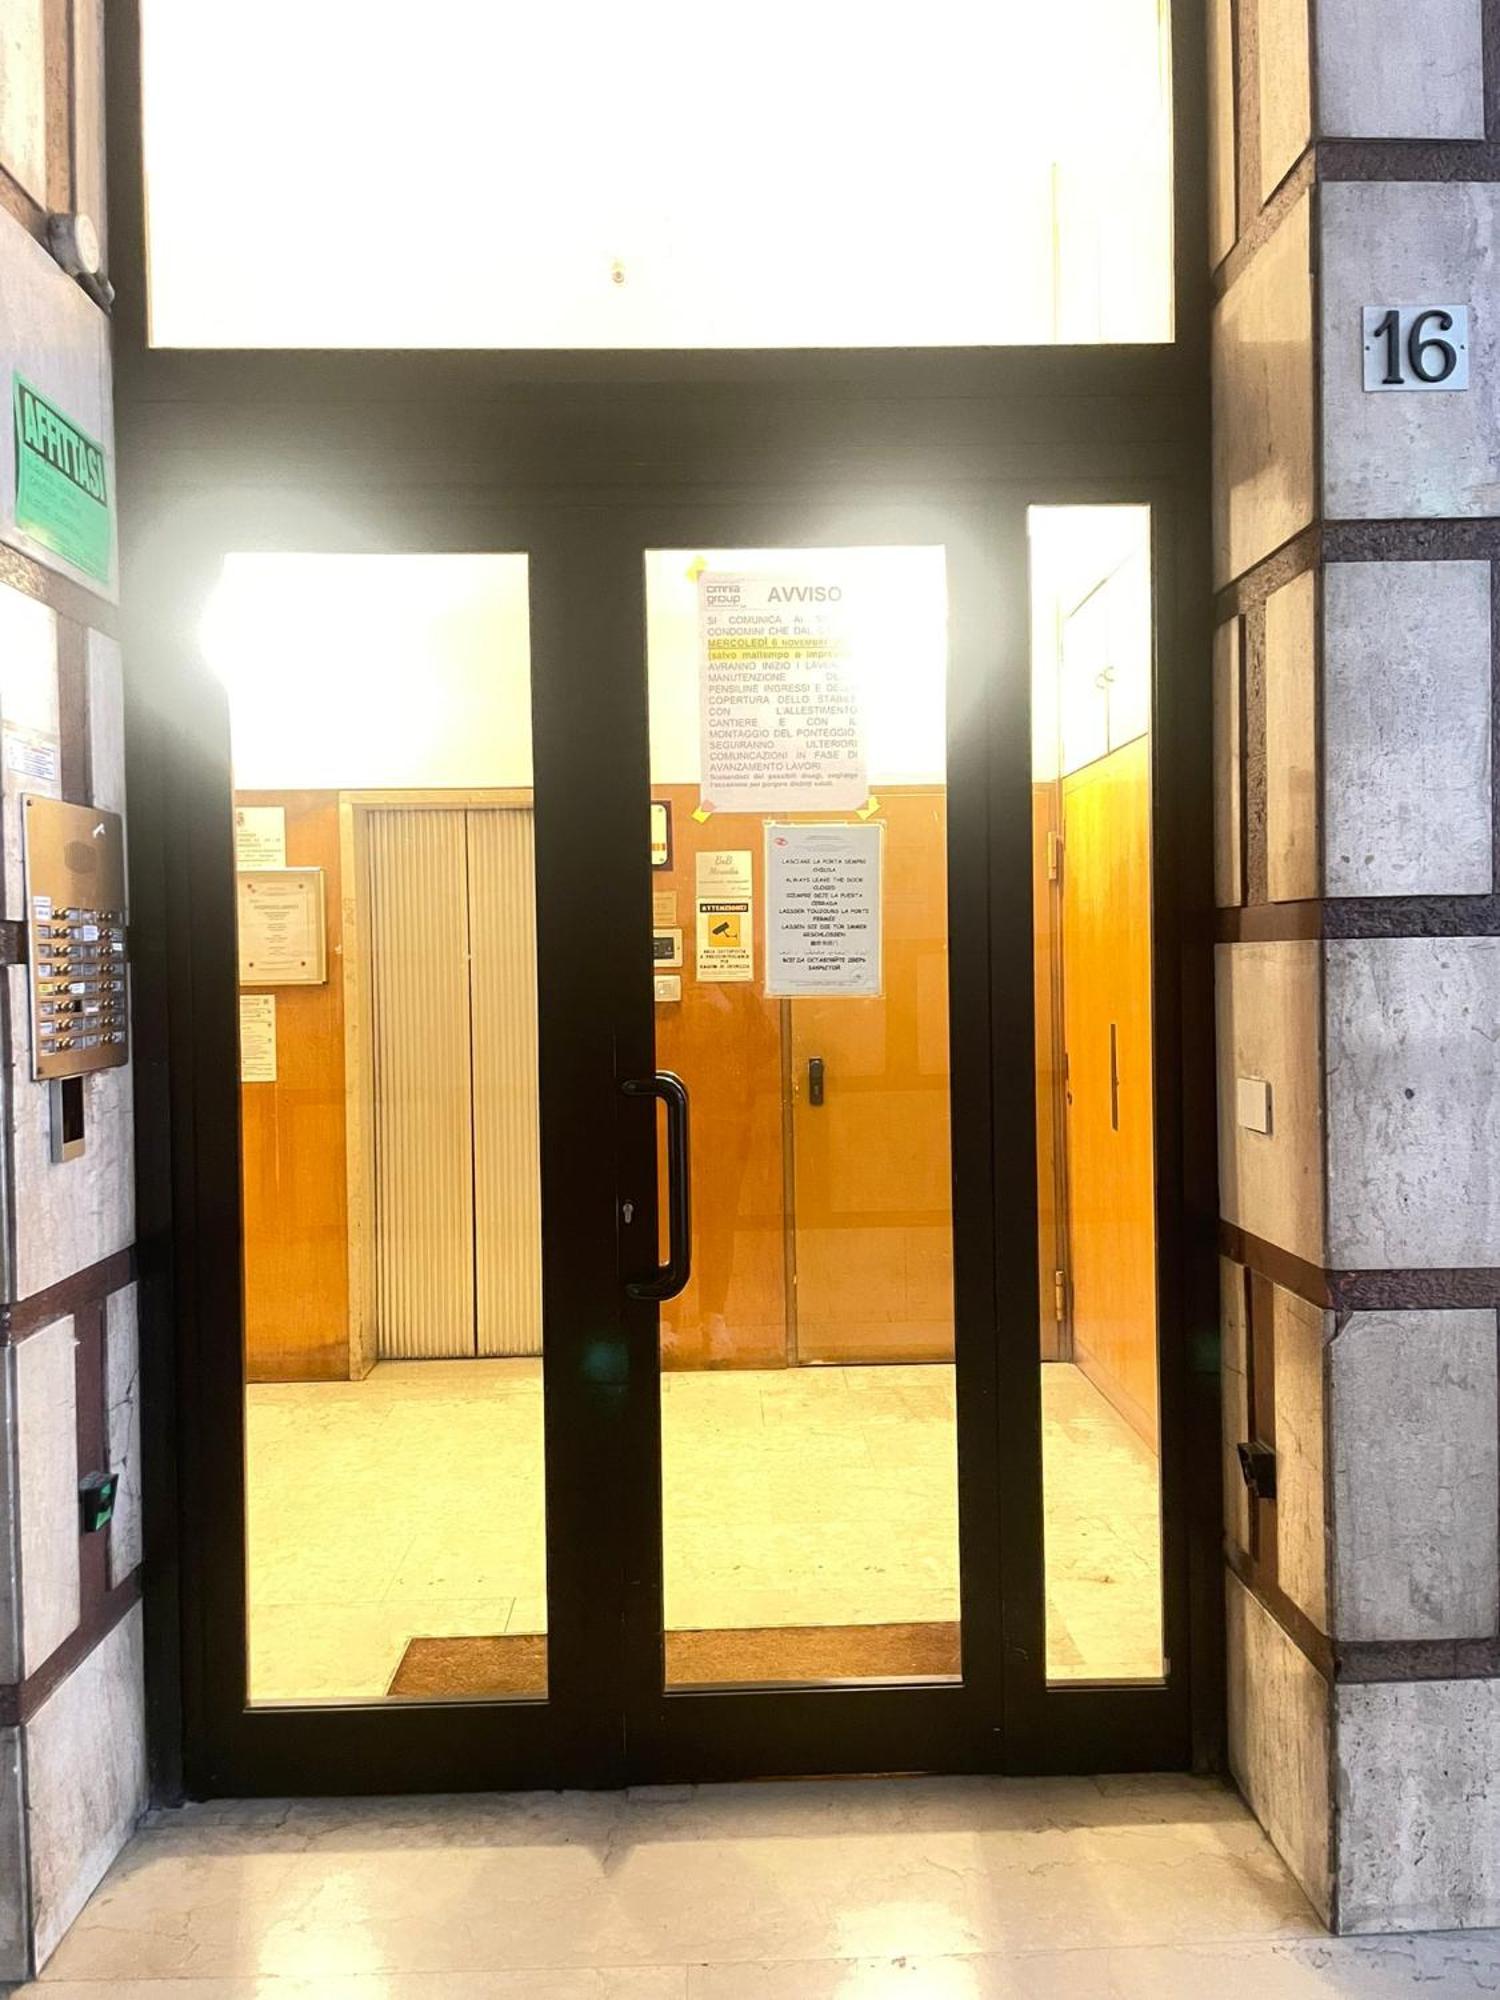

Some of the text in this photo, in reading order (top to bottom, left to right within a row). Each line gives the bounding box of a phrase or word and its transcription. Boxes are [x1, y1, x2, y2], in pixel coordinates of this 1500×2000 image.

[1374, 310, 1456, 384] 16
[767, 586, 842, 602] AVVISO
[707, 595, 740, 605] group
[707, 616, 717, 625] SI
[728, 615, 782, 625] COMUNICA
[707, 627, 765, 637] CONDOMINI
[768, 626, 789, 636] CHE
[708, 651, 737, 661] (salvo
[742, 650, 790, 660] maltempo
[708, 662, 756, 671] AVRANNO
[762, 661, 790, 670] INIZIO
[708, 673, 786, 682] MANUTENZIONE
[708, 684, 759, 693] PENSILINE
[764, 684, 810, 693] INGRESSI
[815, 684, 821, 692] E
[708, 696, 769, 705] COPERTURA
[777, 695, 809, 704] DELLO
[708, 706, 857, 716] CON L'ALLESTIMENTO
[708, 718, 758, 727] CANTIERE
[779, 718, 786, 726] E
[806, 717, 828, 726] CON
[709, 728, 855, 739] MONTAGGIO DEL PONTEGGIO
[709, 740, 857, 750] SEGUIRANNO ULTERIORI
[709, 750, 857, 761] COMUNICAZIONI IN FASE DI
[710, 761, 821, 772] AVANZAMENTO LAVORI
